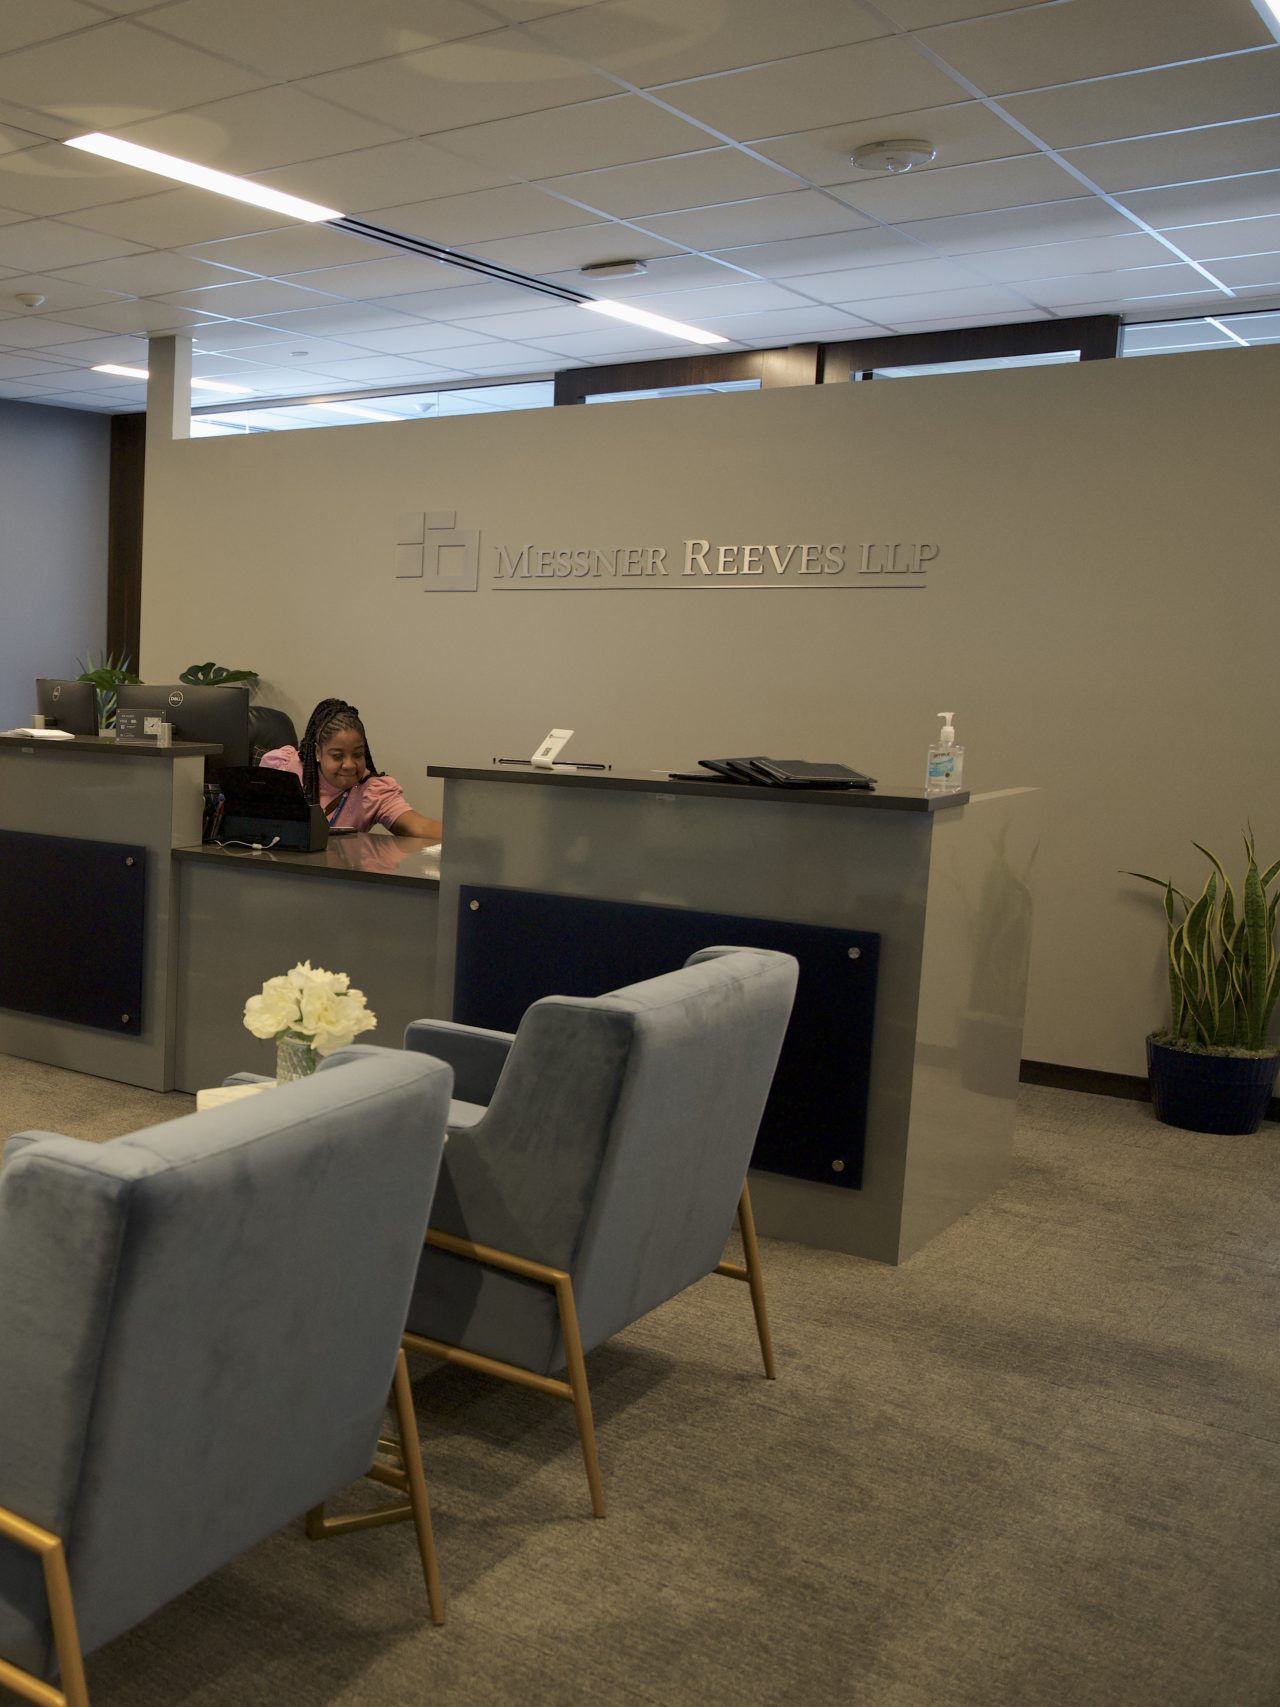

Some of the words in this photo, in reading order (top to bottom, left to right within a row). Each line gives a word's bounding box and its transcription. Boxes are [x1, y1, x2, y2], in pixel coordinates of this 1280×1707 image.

[493, 544, 669, 578] MESSNER
[682, 539, 845, 576] REEVES
[857, 543, 940, 574] LLP
